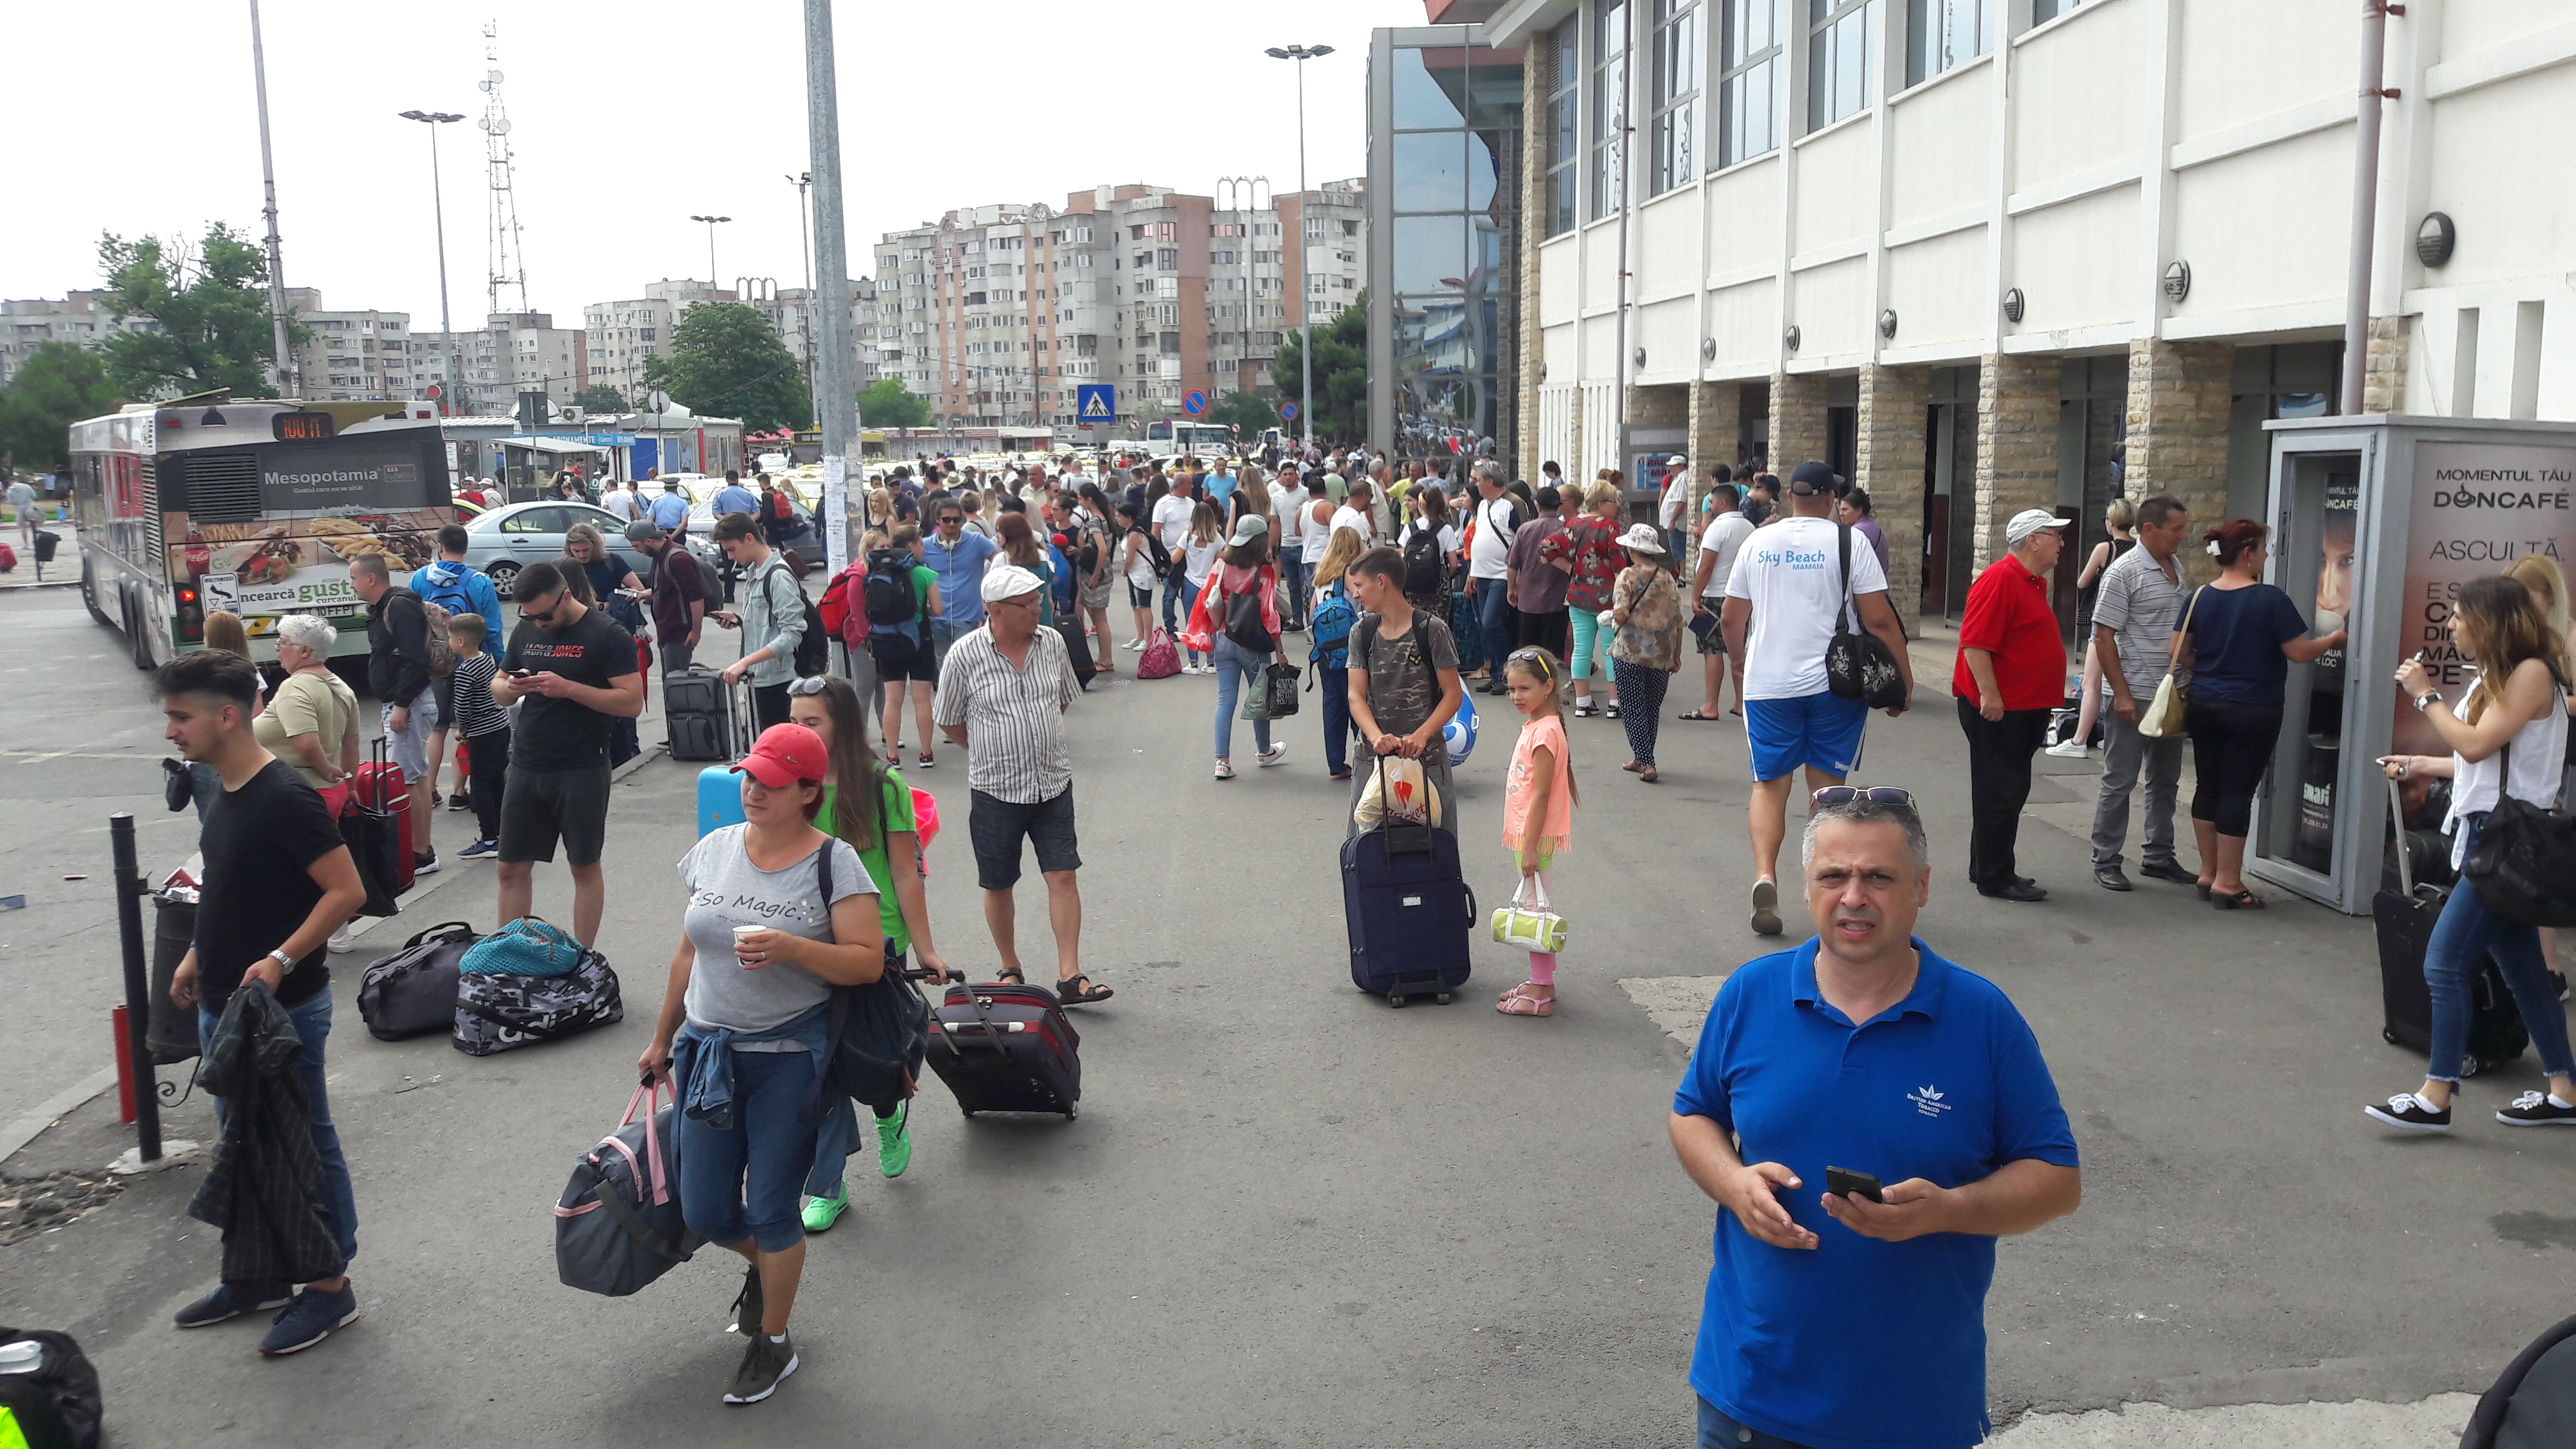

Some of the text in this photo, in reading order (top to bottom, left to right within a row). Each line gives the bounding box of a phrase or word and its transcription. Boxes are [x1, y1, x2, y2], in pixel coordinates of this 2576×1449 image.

[264, 469, 379, 486] Mesopotamia
[2436, 468, 2572, 482] MOMENTUL TĂU
[1758, 550, 1825, 567] Sky Beach
[240, 579, 351, 603] ncearcă gust
[316, 595, 357, 603] curcanul
[700, 892, 797, 919] So Magic
